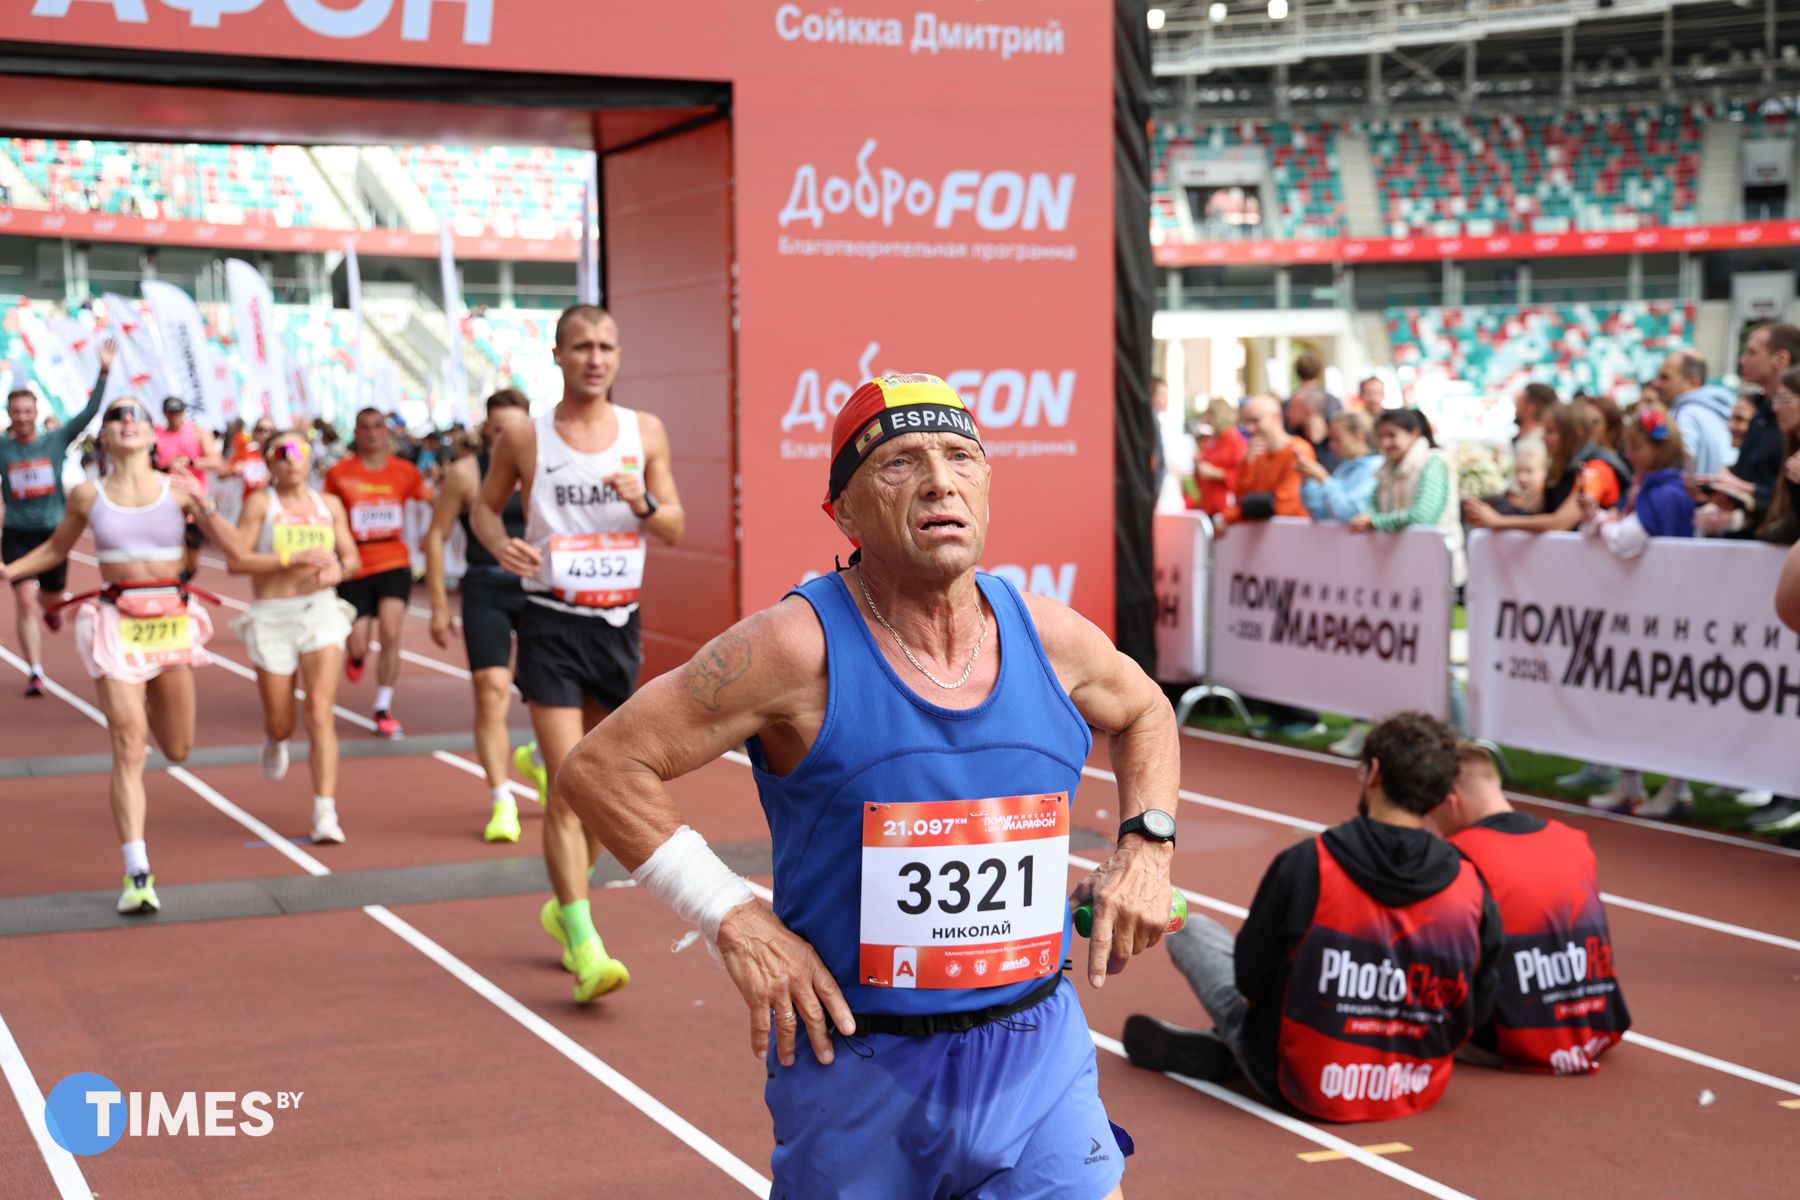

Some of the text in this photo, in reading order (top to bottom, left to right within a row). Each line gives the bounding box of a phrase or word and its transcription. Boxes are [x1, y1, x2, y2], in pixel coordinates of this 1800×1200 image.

[775, 3, 1066, 60] Сойкка Дмитрий
[890, 408, 974, 434] ESPAÑA
[568, 556, 629, 578] 4352
[132, 621, 178, 642] 2771
[1610, 611, 1800, 653] МИНСКИ
[883, 818, 955, 836] 21.097
[1001, 818, 1056, 832] МАРАФОН
[896, 854, 1034, 915] 3321
[932, 921, 1012, 939] НИКОЛАЙ
